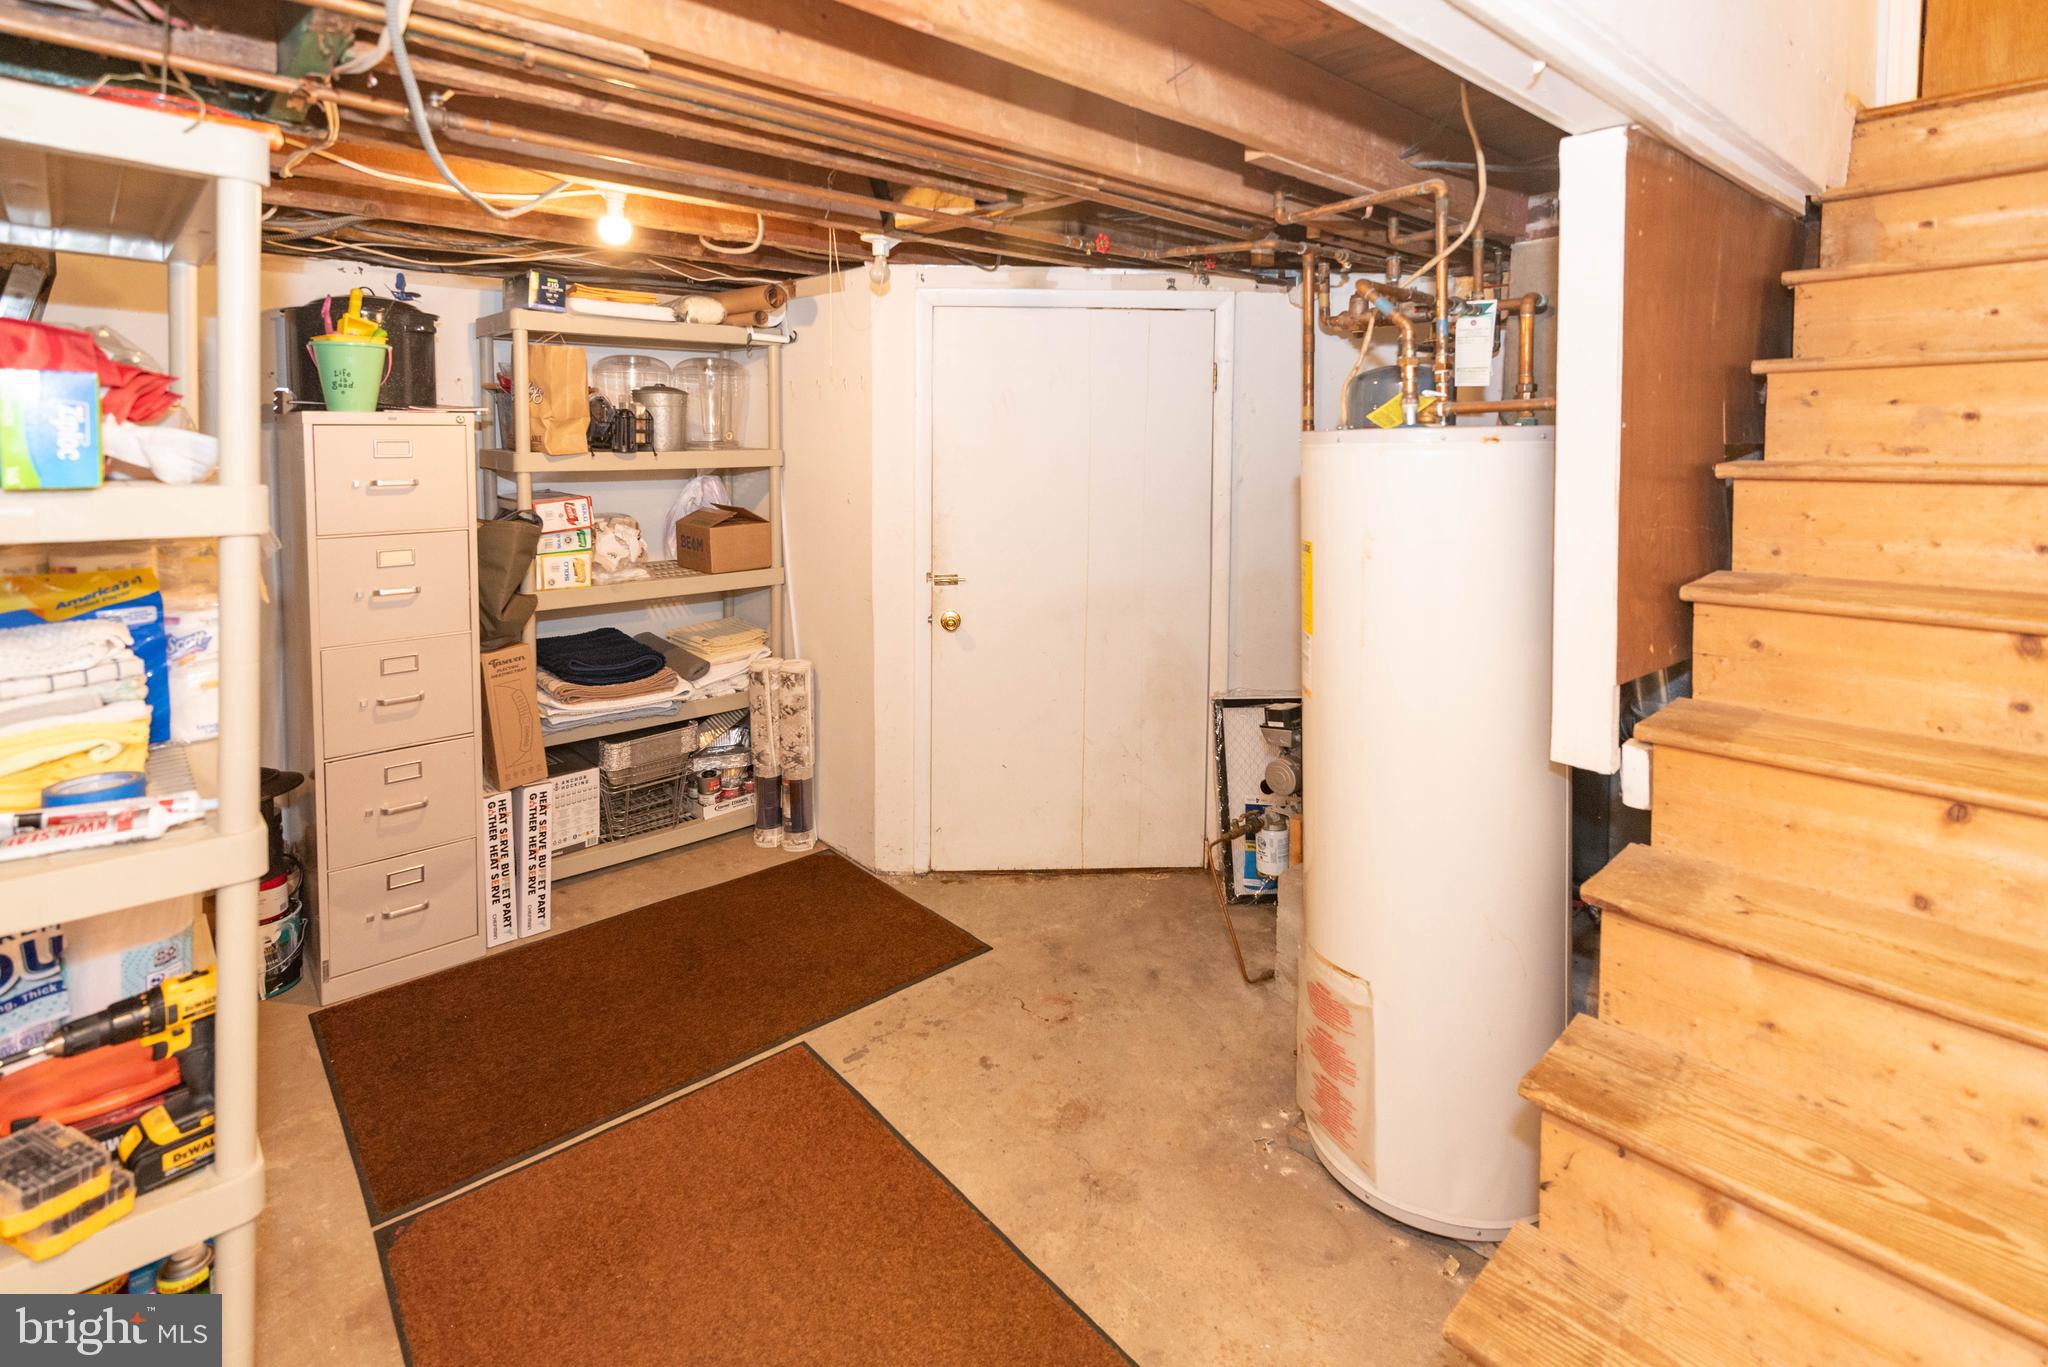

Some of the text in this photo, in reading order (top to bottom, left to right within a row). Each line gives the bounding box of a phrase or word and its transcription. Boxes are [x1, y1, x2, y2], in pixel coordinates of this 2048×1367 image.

[334, 368, 351, 377] Life
[332, 381, 354, 390] good
[680, 535, 704, 552] BEAM
[56, 578, 130, 610] America's
[561, 775, 587, 785] ANCHOR
[561, 780, 589, 790] HOCKING
[488, 802, 497, 841] GATHER
[529, 793, 537, 832] GATHER
[490, 845, 499, 870] HEAT
[528, 836, 537, 861] HEAT
[537, 791, 547, 927] HEAT SERVE BUFFET PARTY
[498, 799, 513, 935] HEAT SERVE BUFFET PARTY
[528, 864, 536, 895] SERVE
[491, 873, 500, 905] SERVE
[21, 983, 58, 1001] Thick
